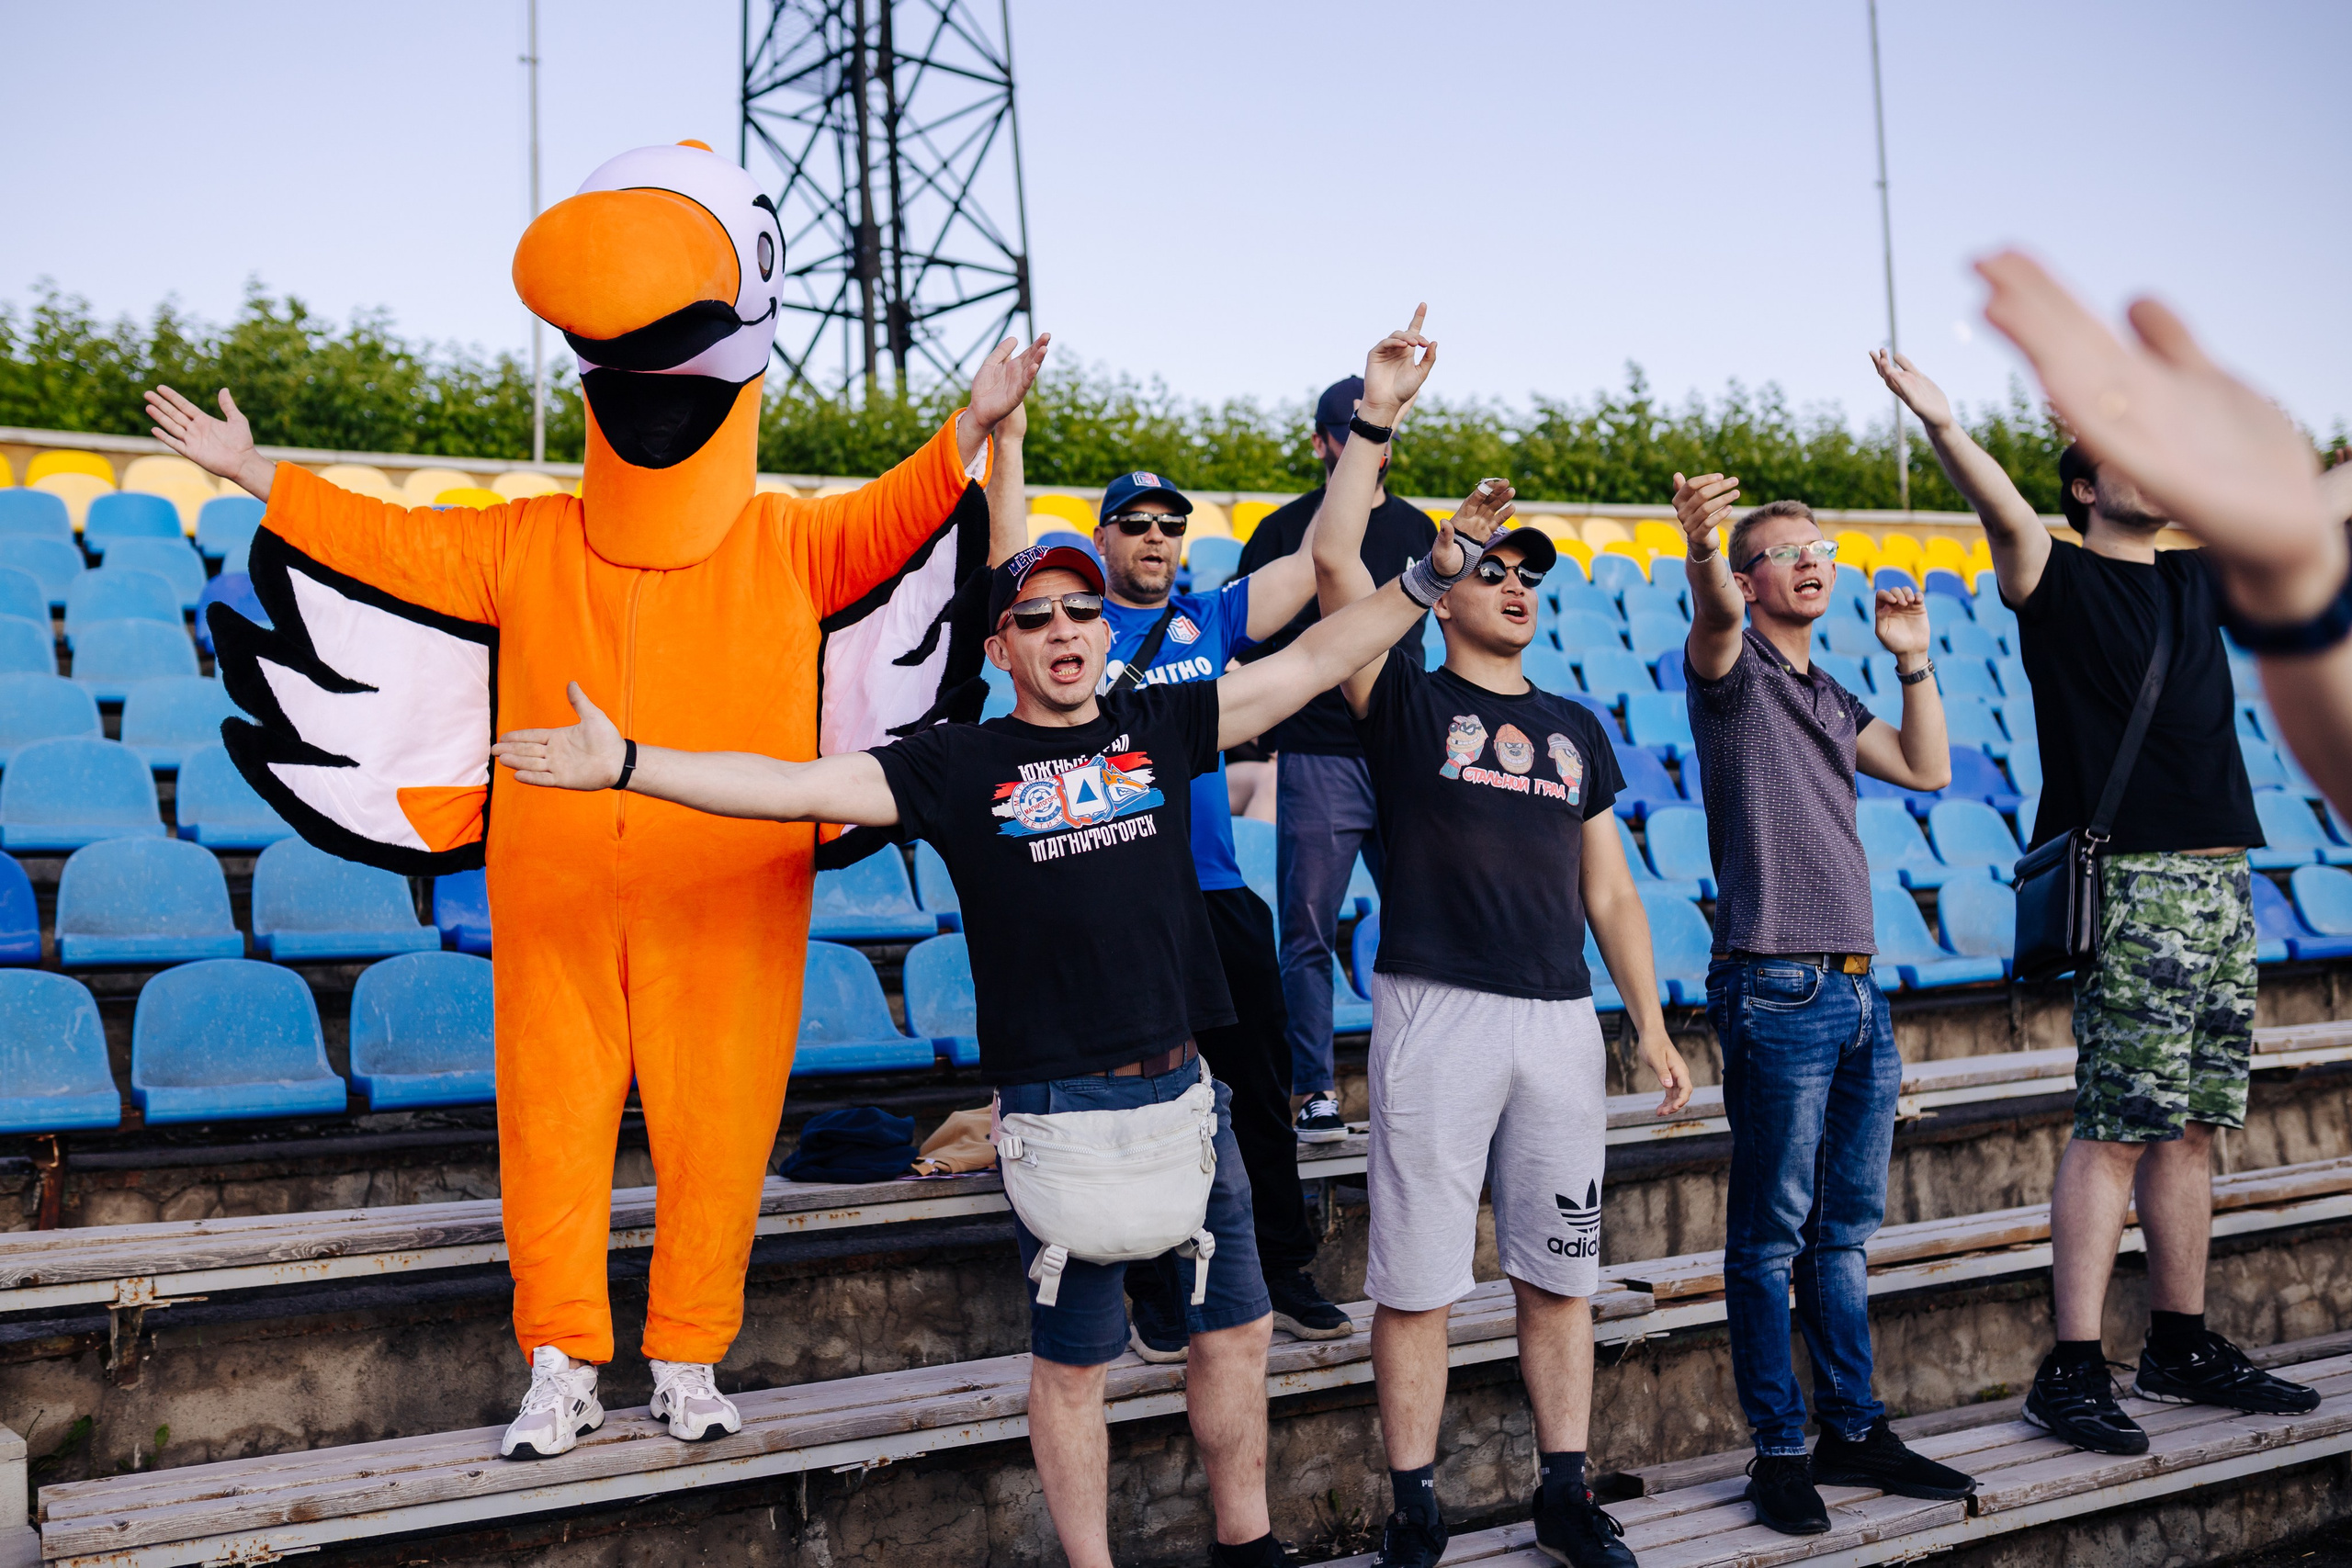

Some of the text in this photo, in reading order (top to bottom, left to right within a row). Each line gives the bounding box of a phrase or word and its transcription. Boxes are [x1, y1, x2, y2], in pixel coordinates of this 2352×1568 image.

[1134, 656, 1213, 689] ИТНО
[1463, 766, 1566, 800] СТАЛЬНОЙ ГРАД
[1024, 794, 1058, 815] МАГНИТОГОРС
[1028, 813, 1158, 863] МАГНИТОГОРСК
[1547, 1234, 1600, 1258] adid
